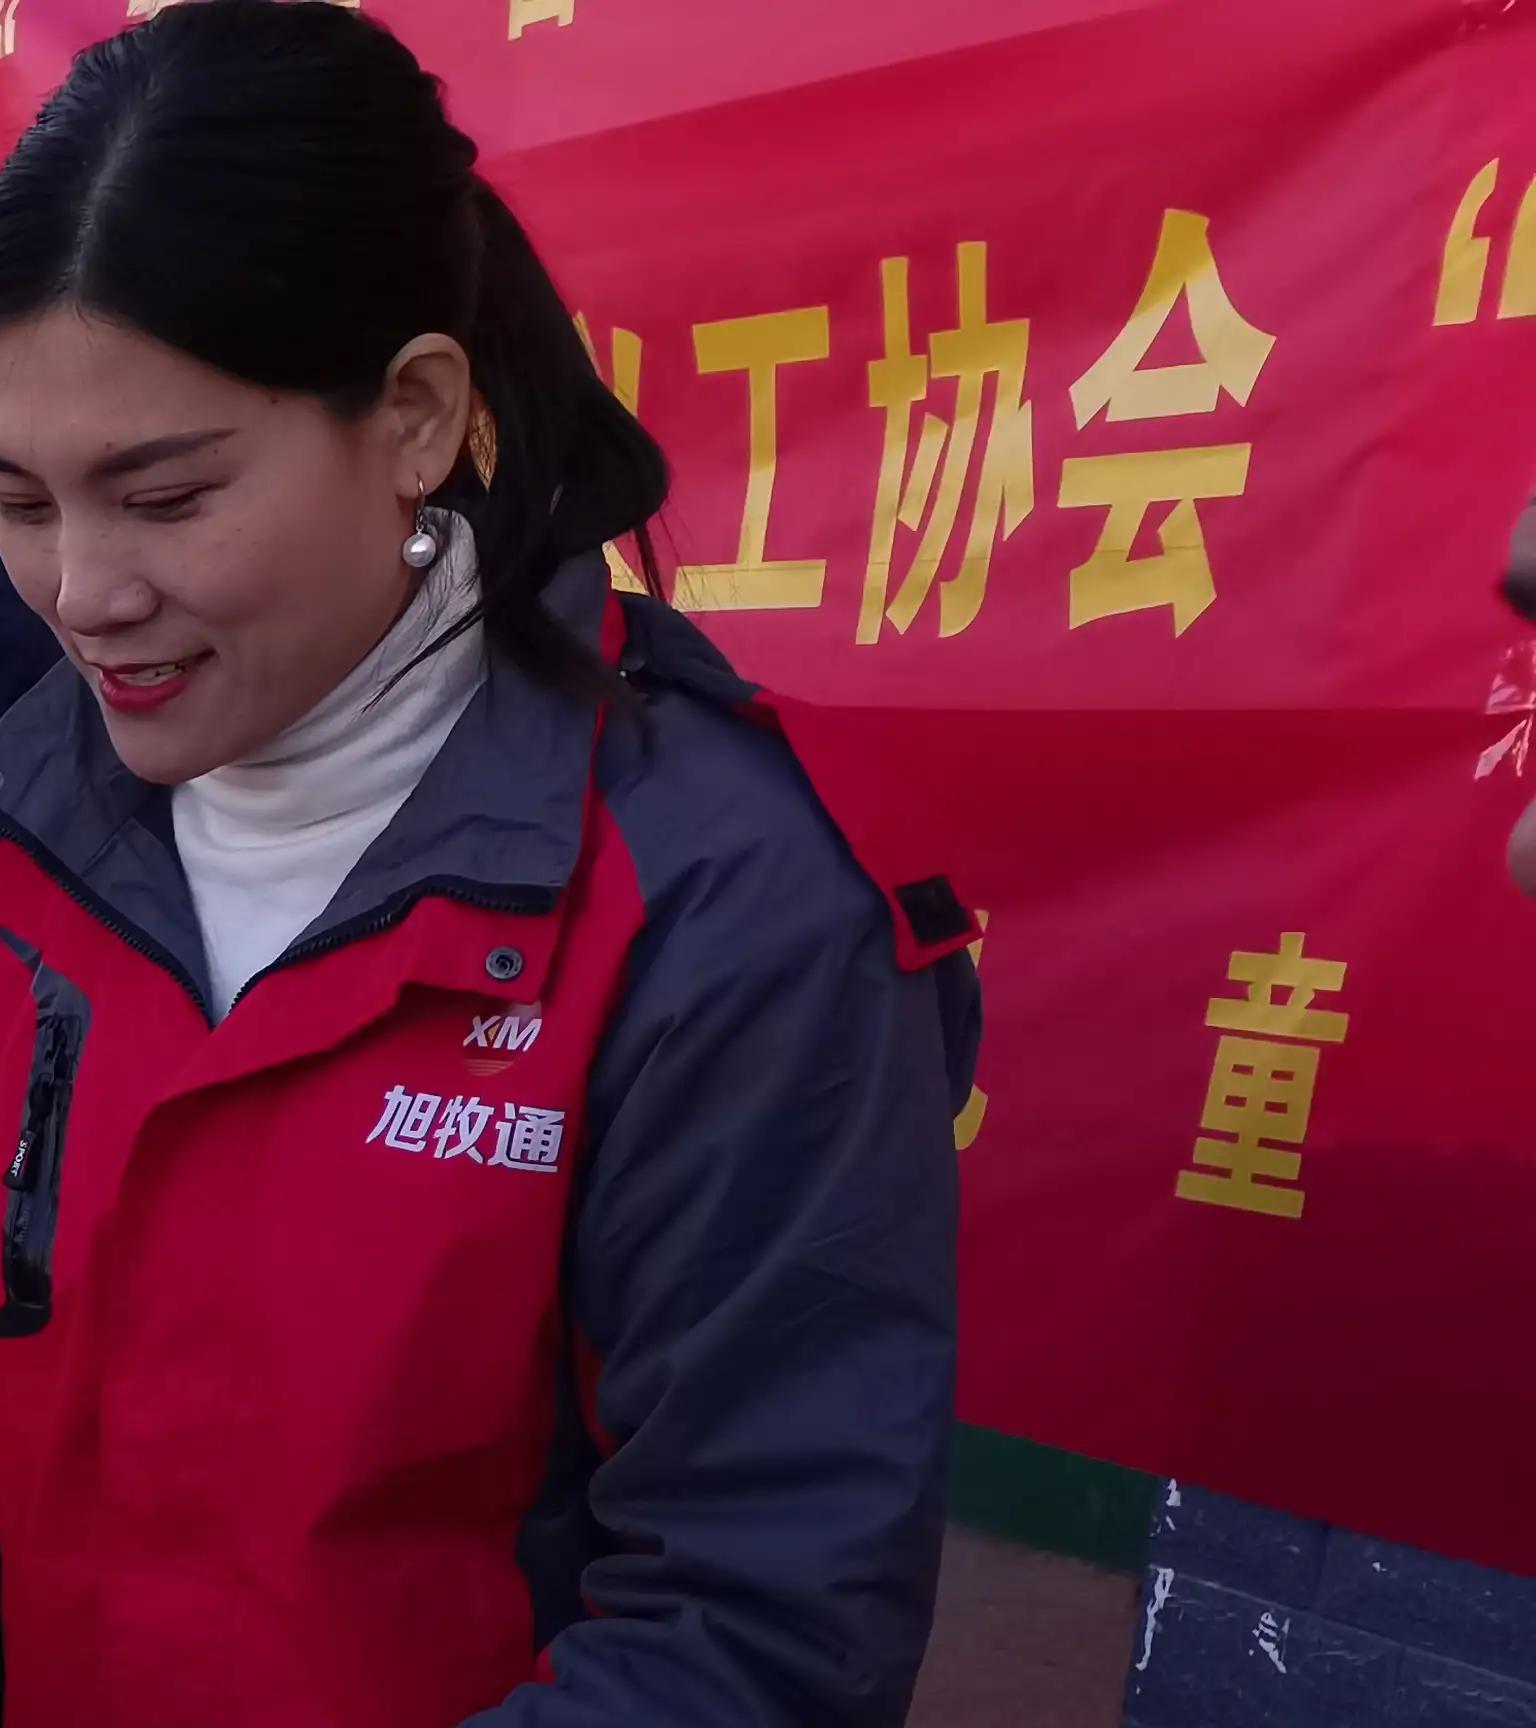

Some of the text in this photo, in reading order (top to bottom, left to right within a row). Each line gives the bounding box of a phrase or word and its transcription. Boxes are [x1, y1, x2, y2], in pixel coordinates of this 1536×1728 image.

[568, 206, 1278, 642] 工协会
[11, 1139, 29, 1177] SPORT
[365, 1084, 566, 1174] 旭牧通
[1174, 931, 1350, 1219] 童
